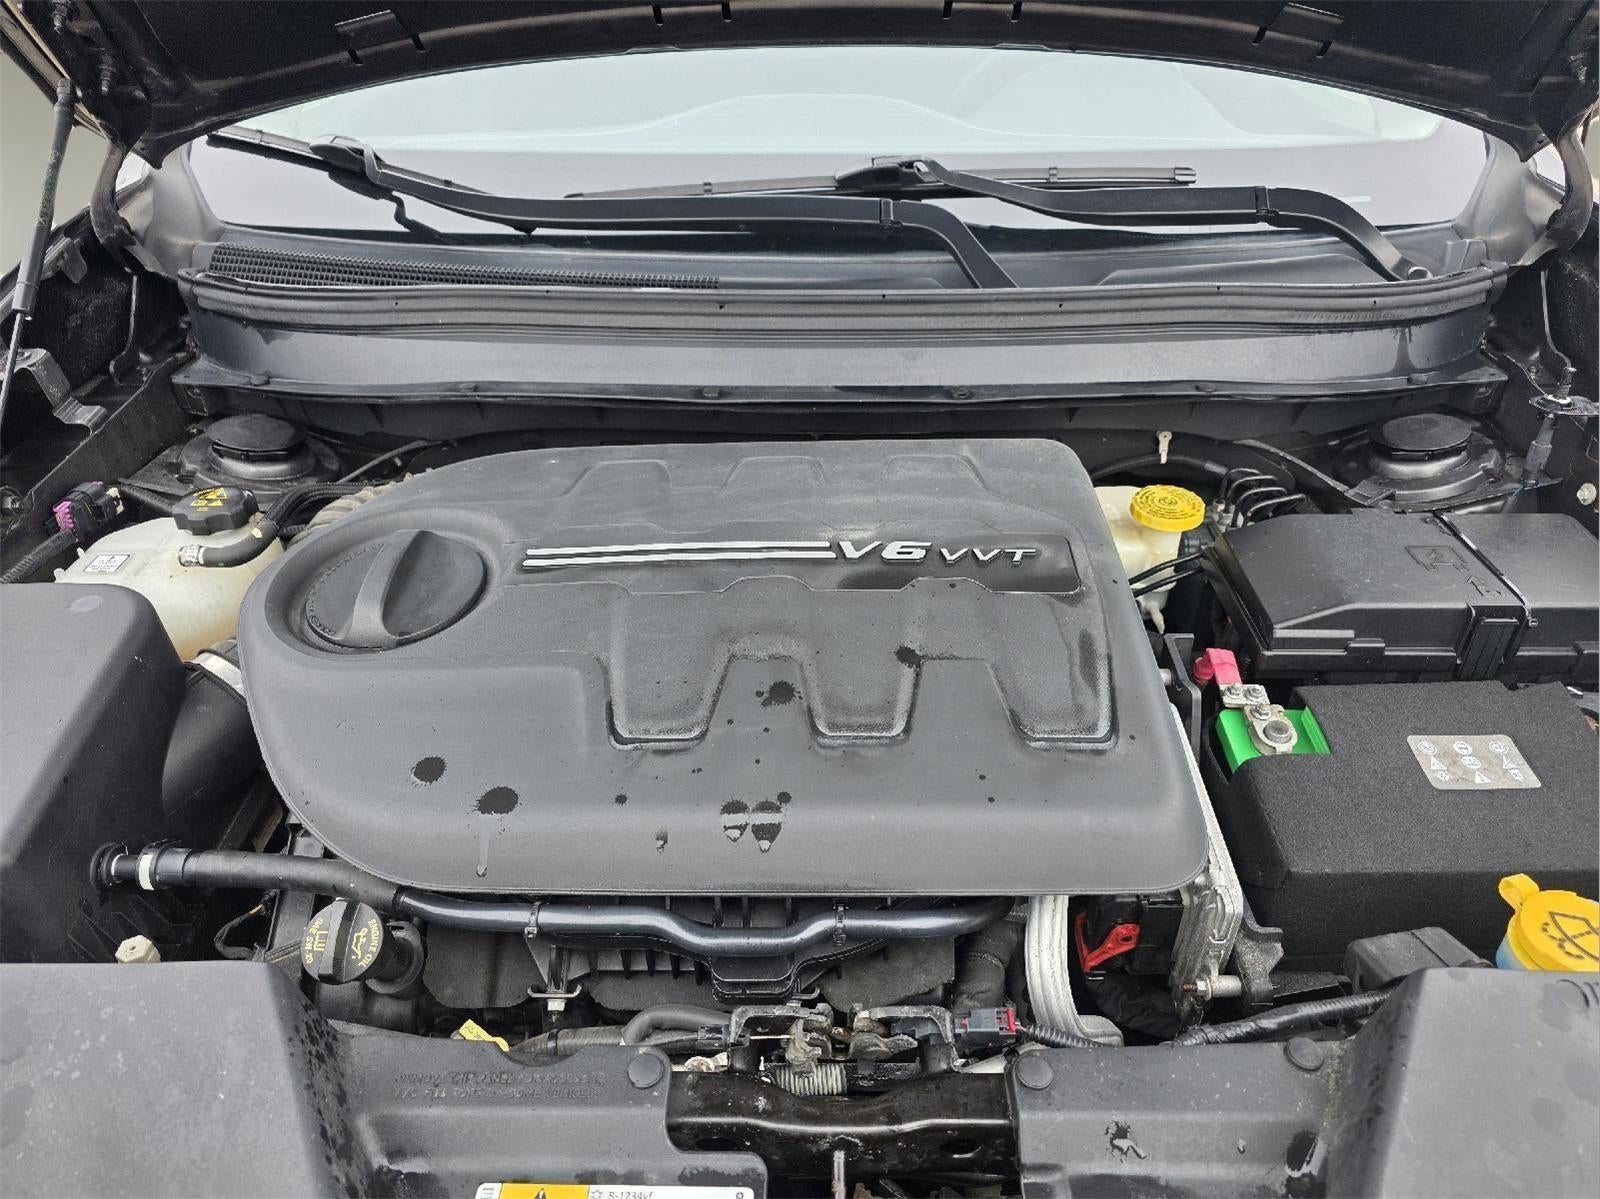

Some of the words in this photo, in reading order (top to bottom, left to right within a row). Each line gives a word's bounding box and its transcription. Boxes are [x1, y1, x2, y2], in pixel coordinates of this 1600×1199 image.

[838, 541, 933, 561] V6
[940, 547, 1036, 564] VVT
[309, 918, 324, 934] SAE
[368, 918, 380, 953] ENGINE
[305, 936, 314, 964] 5W-20
[358, 954, 373, 968] OIL
